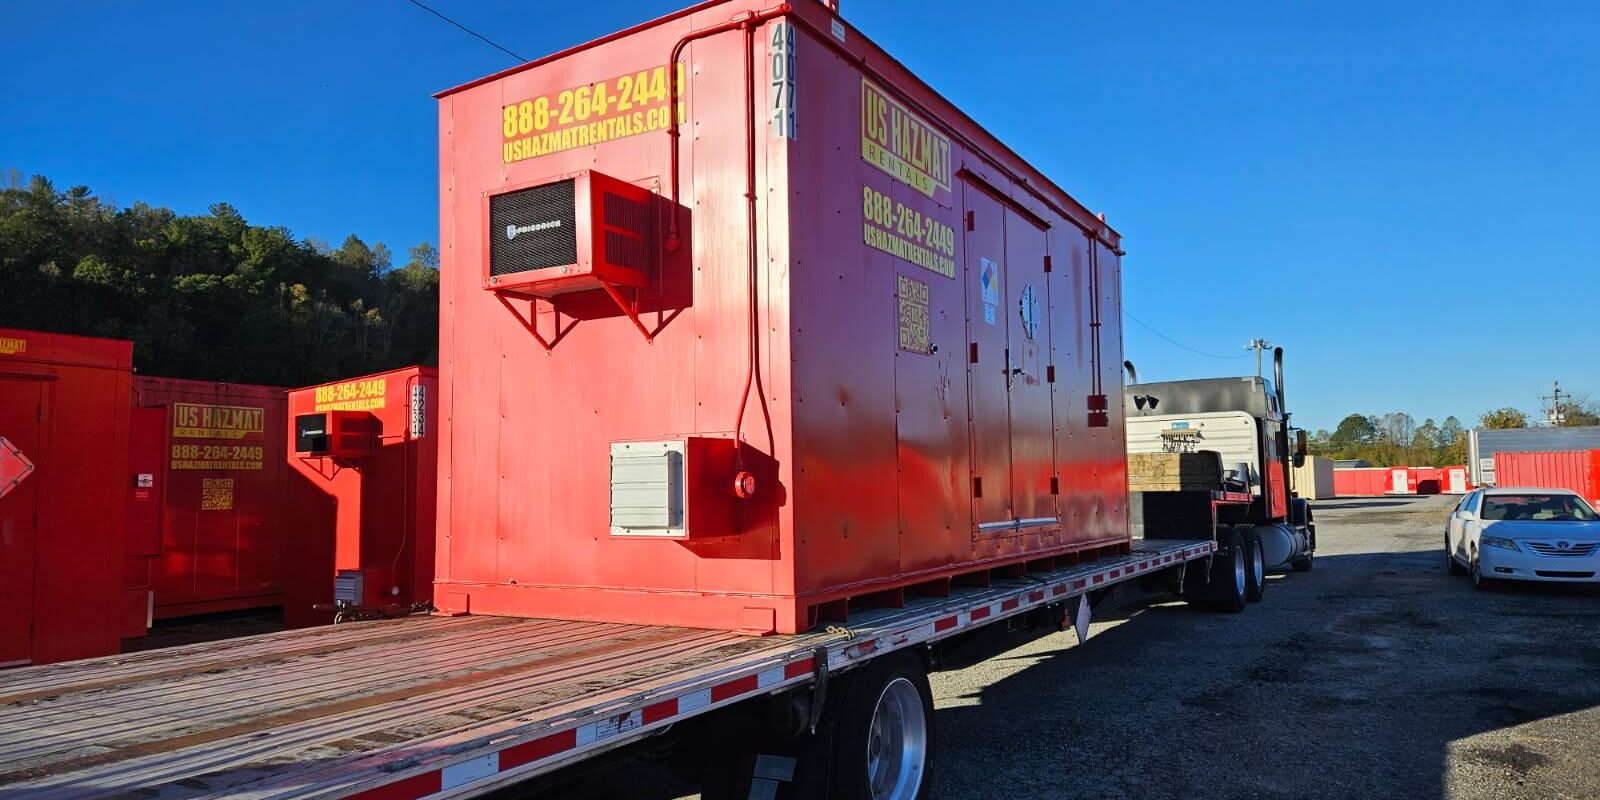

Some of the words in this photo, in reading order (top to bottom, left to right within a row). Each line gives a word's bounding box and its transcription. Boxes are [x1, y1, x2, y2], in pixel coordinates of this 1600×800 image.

[503, 62, 685, 138] 888-264-2449
[772, 23, 784, 137] 4071
[787, 25, 795, 139] 4071
[867, 88, 887, 146] US
[892, 106, 948, 184] HAZMAT
[869, 144, 928, 190] RENTALS
[864, 186, 954, 256] 888-264-2449
[864, 223, 955, 278] USHAZMATRENTALS.COM
[179, 406, 198, 427] US
[203, 408, 261, 429] HAZMAT
[316, 379, 385, 403] 888-264-2449
[171, 460, 263, 469] USHAZMATRENTALS.COM
[172, 445, 263, 460] 888-264-2449
